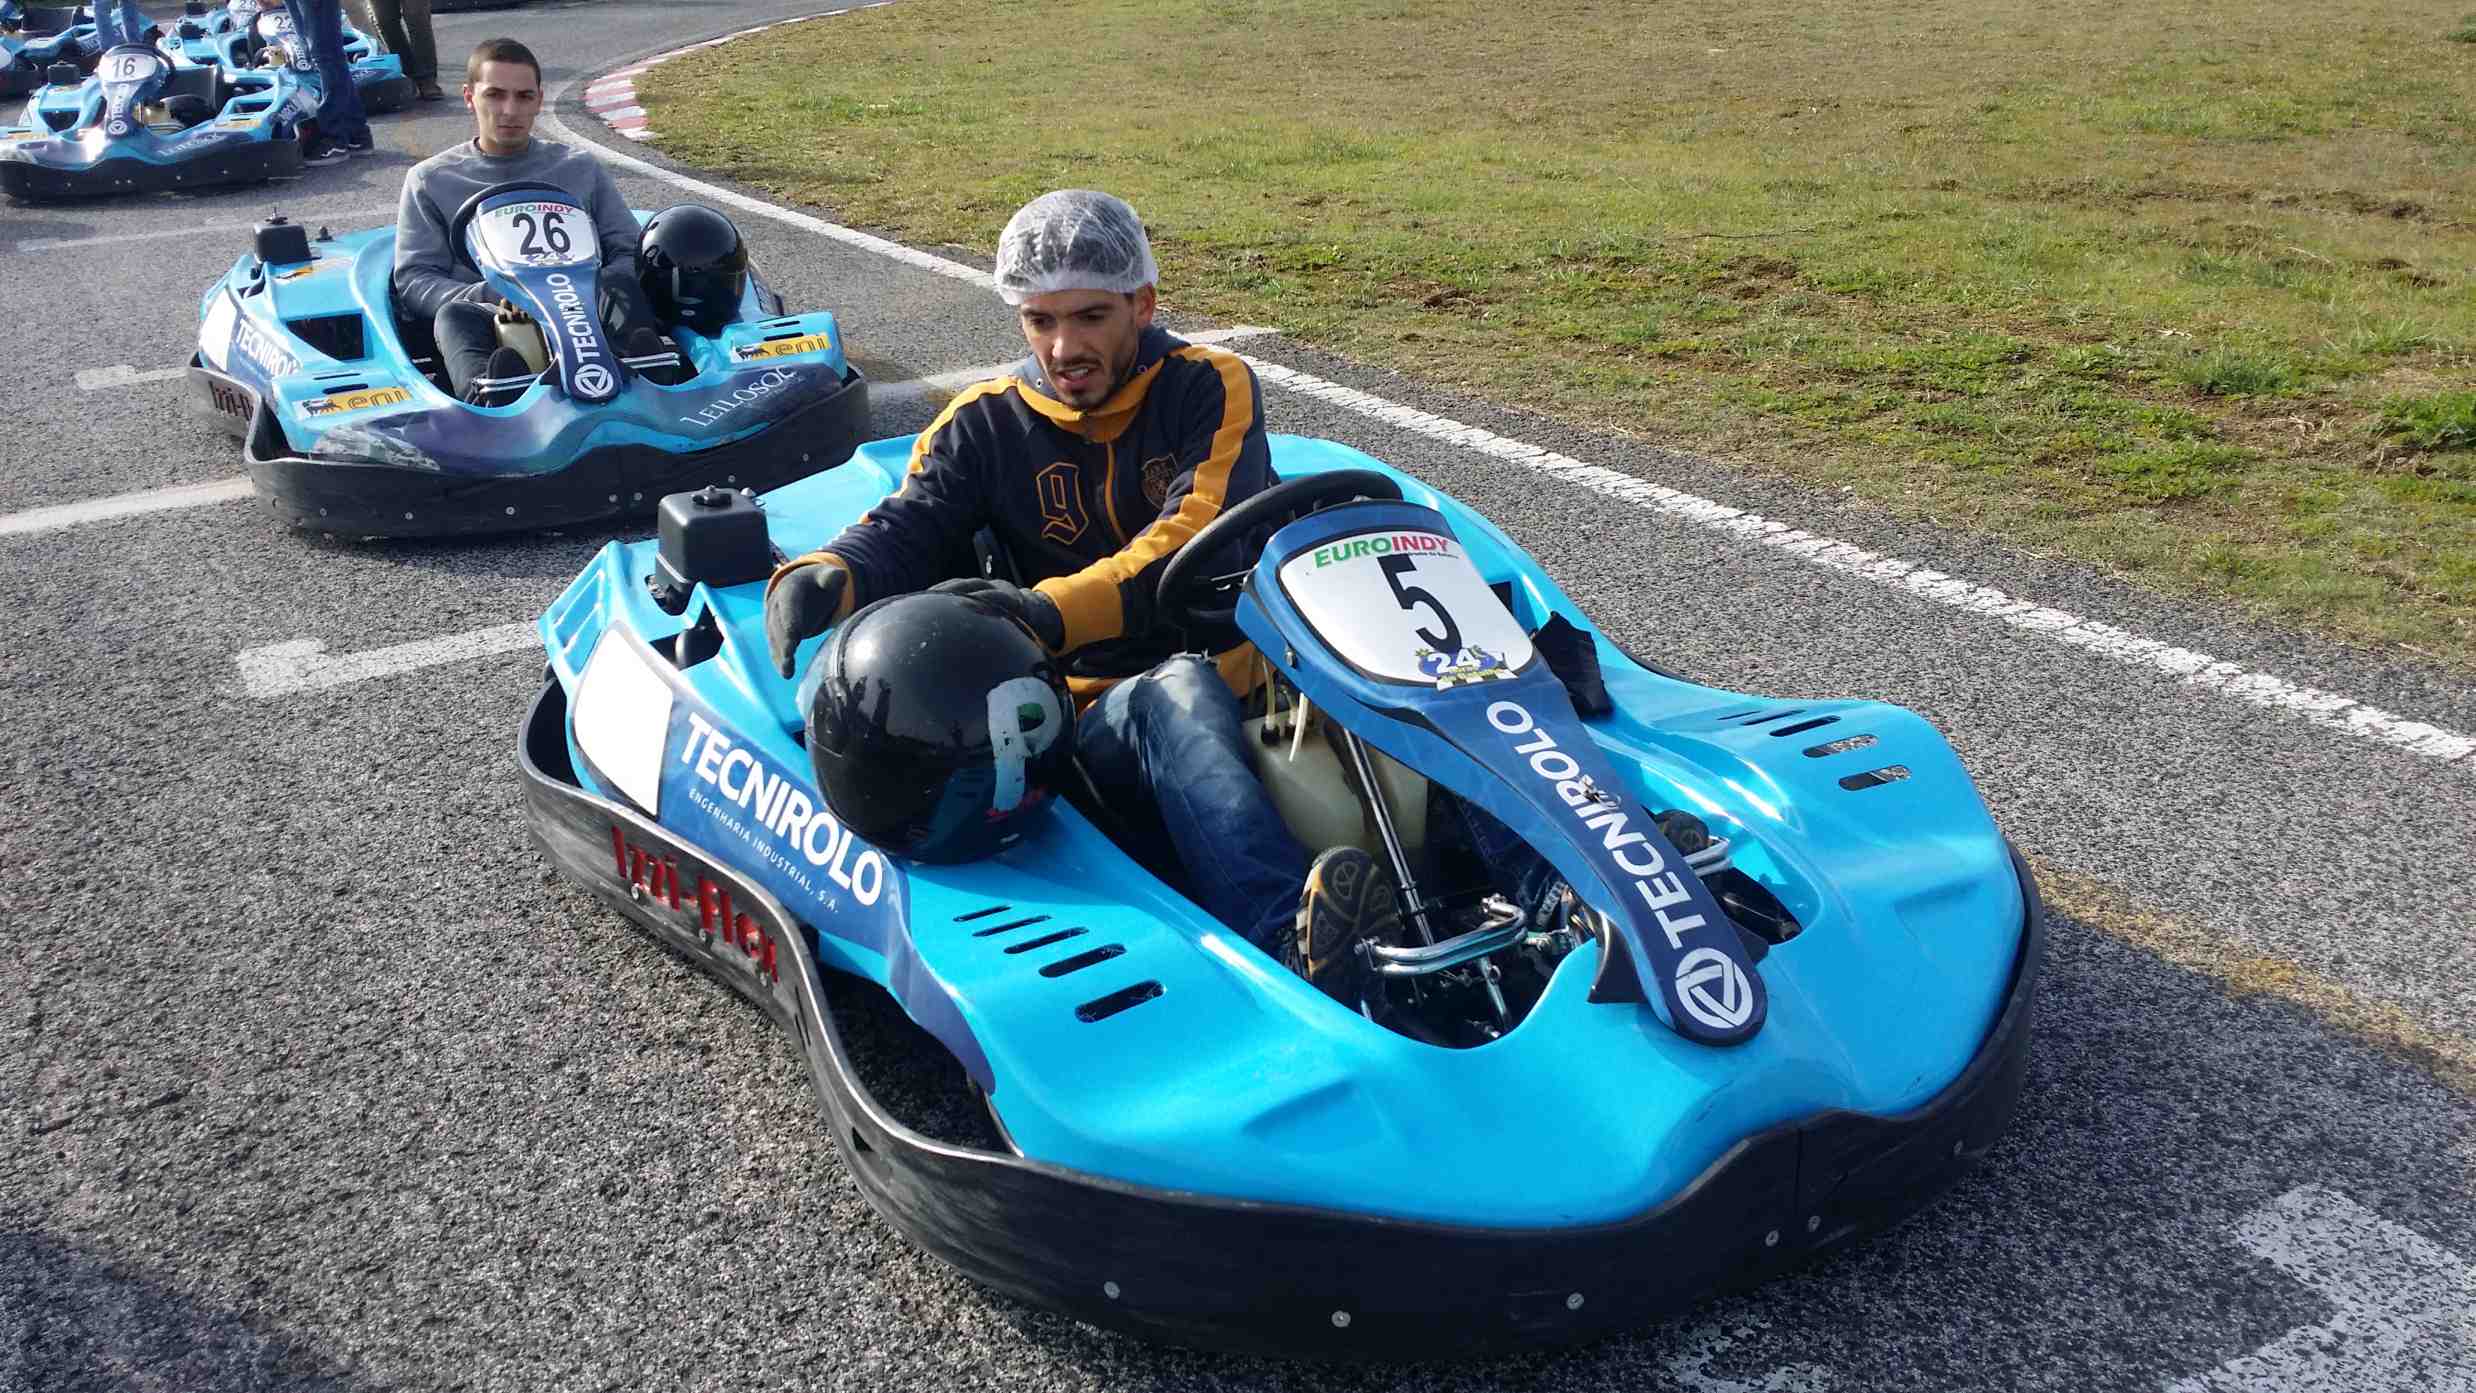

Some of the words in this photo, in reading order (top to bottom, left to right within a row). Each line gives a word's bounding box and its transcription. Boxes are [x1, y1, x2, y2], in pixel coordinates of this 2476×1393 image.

[113, 57, 136, 78] 16
[495, 204, 575, 218] EUROINDY
[512, 212, 571, 256] 26
[546, 273, 601, 363] TECNIROLO
[1314, 535, 1449, 568] EUROINDY
[1377, 553, 1463, 652] 5
[681, 712, 884, 906] TECNIROLO
[688, 787, 750, 843] ENGENHARIA
[752, 837, 814, 896] INDUSTRIAL,
[818, 890, 839, 914] S.A.
[1487, 701, 1707, 950] TECNIROLO
